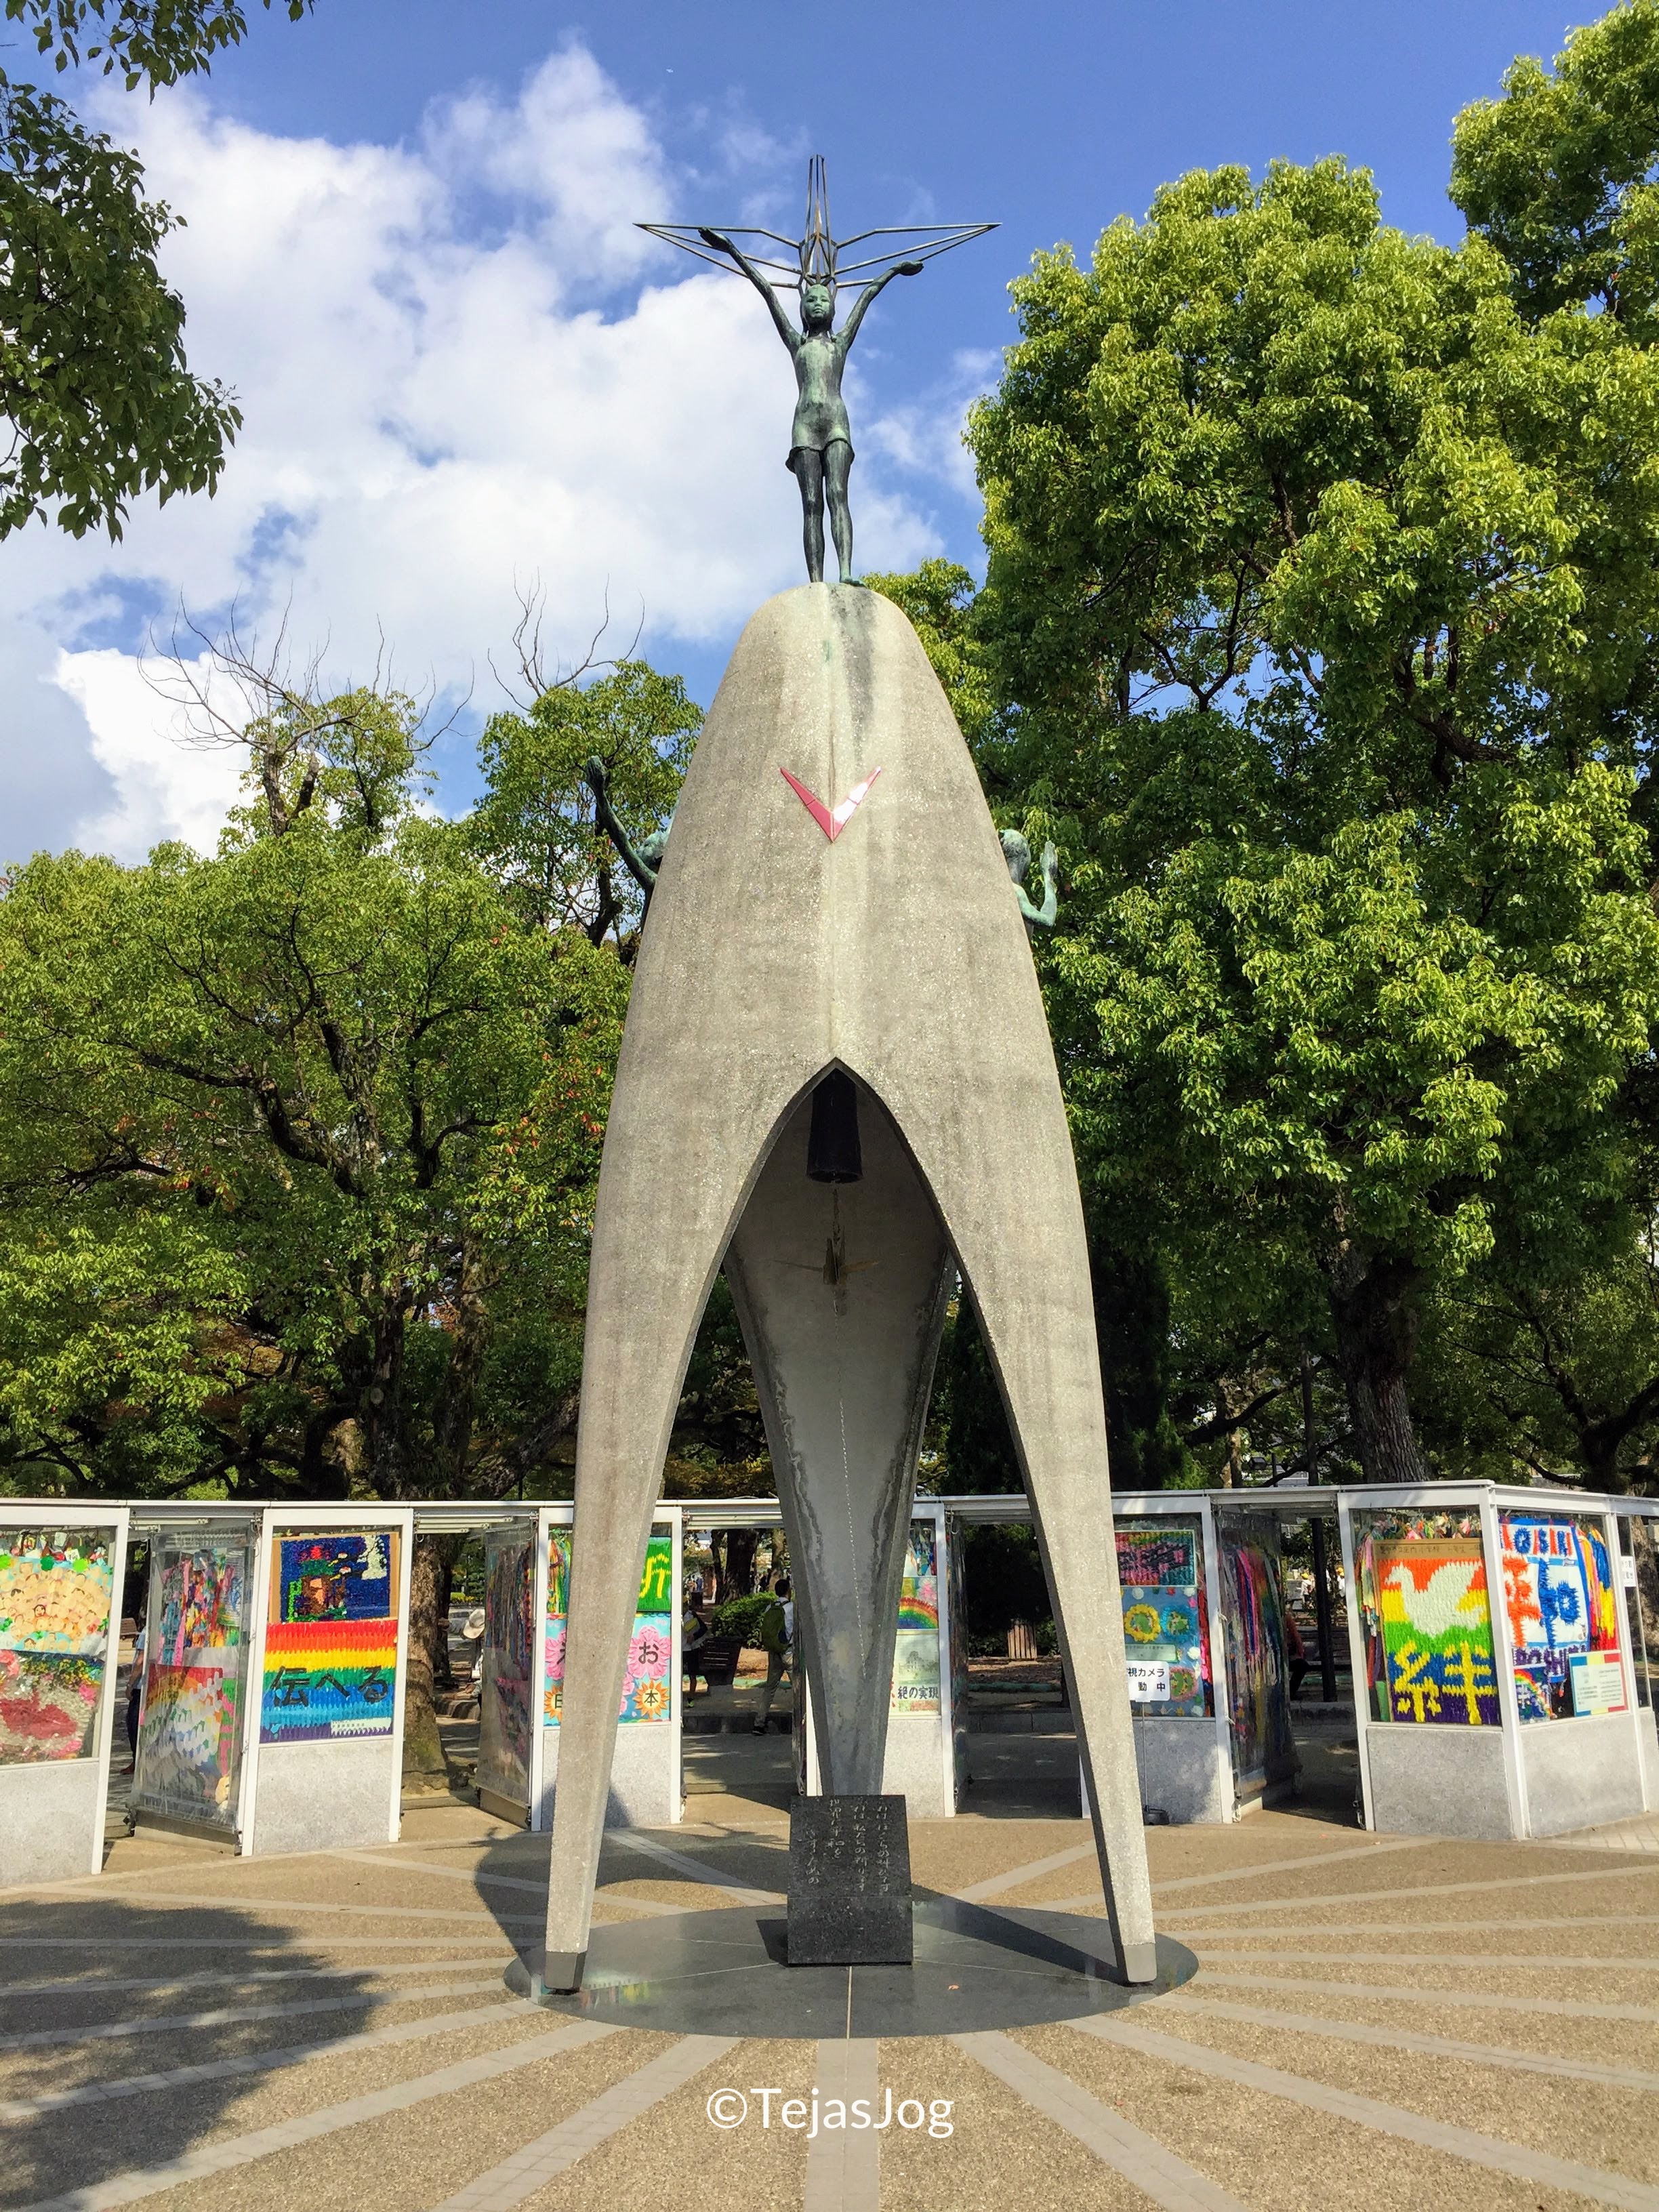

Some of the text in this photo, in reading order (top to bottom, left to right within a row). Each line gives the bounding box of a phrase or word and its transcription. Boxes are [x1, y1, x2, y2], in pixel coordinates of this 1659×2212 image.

[638, 1641, 659, 1664] お
[270, 1665, 388, 1707] 伝へる
[644, 1689, 659, 1706] 本
[1393, 1639, 1498, 1726] 絆
